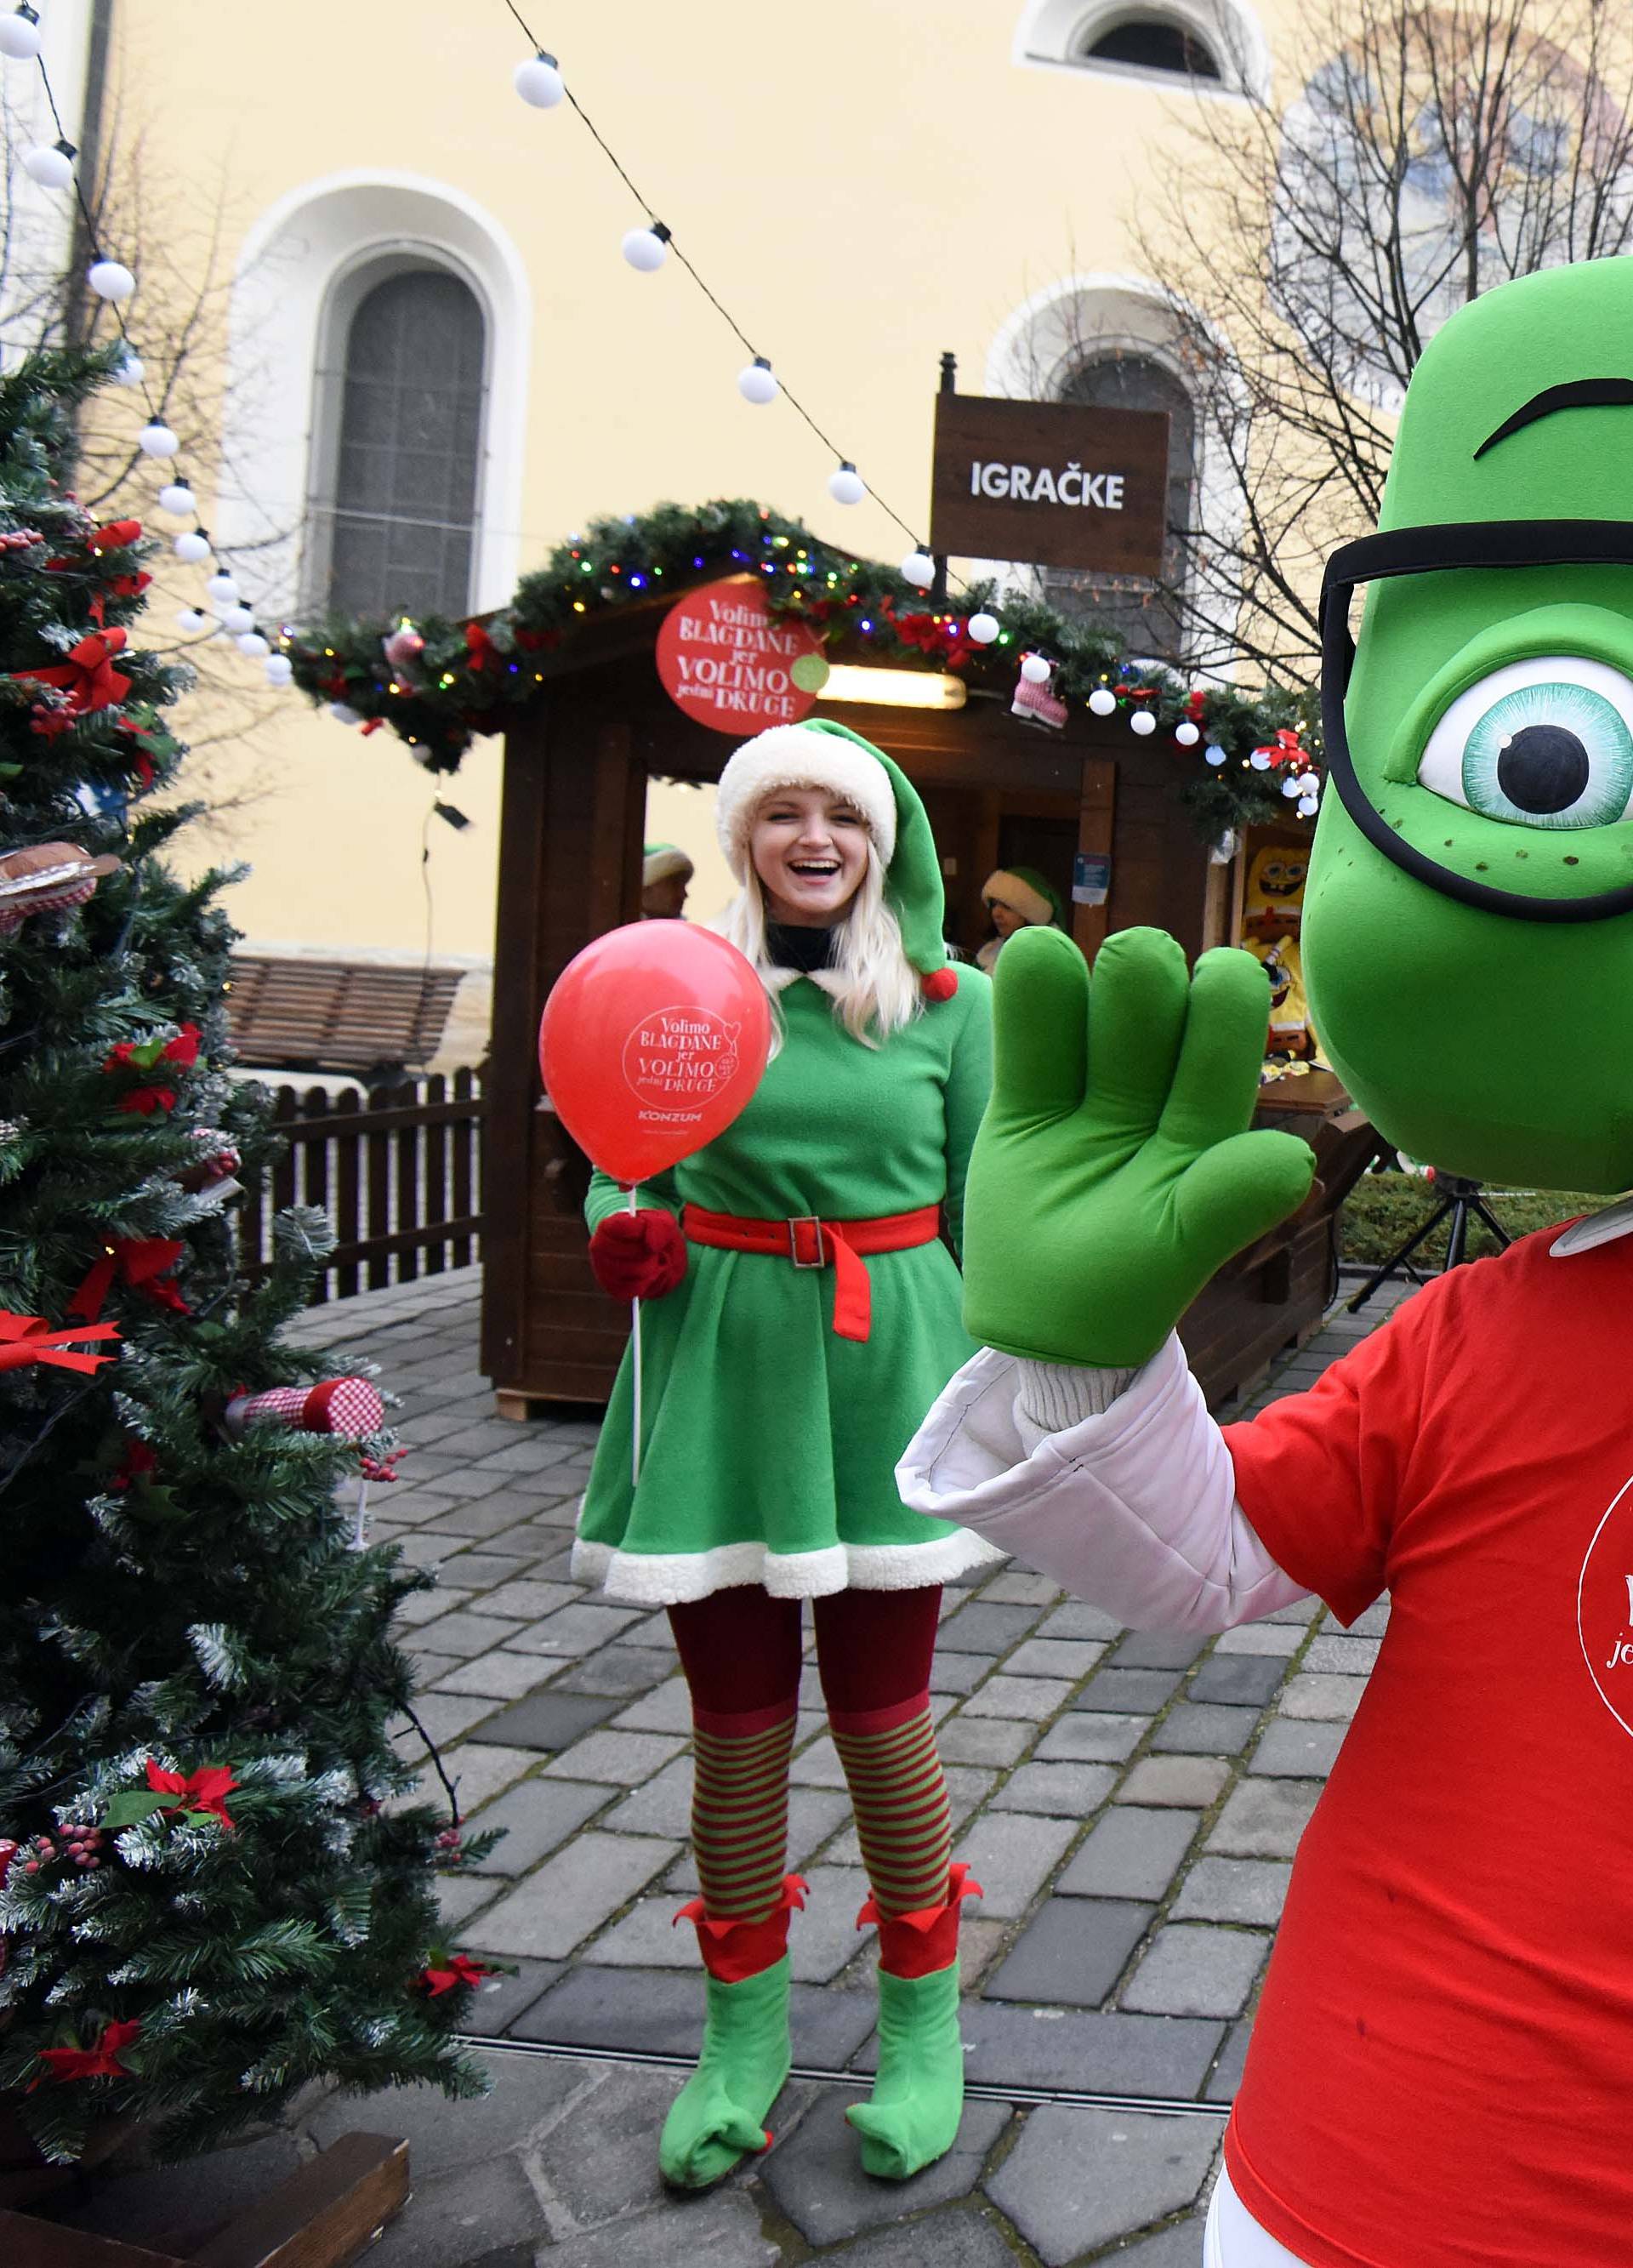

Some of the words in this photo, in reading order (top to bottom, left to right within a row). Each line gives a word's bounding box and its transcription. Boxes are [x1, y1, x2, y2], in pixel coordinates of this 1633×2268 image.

[971, 462, 1124, 510] IGRAČKE
[710, 599, 770, 626] Volim
[680, 616, 798, 655] BLAGDANE
[731, 649, 758, 666] jer
[678, 655, 789, 694] VOLIMO
[714, 687, 797, 718] DRUGE
[661, 1017, 711, 1034] Volimo
[640, 1030, 722, 1051] BLAGDANE
[675, 1050, 695, 1063] jer
[639, 1057, 714, 1078] VOLIMO
[664, 1077, 717, 1092] DRUGE
[639, 1110, 703, 1123] KONZUM
